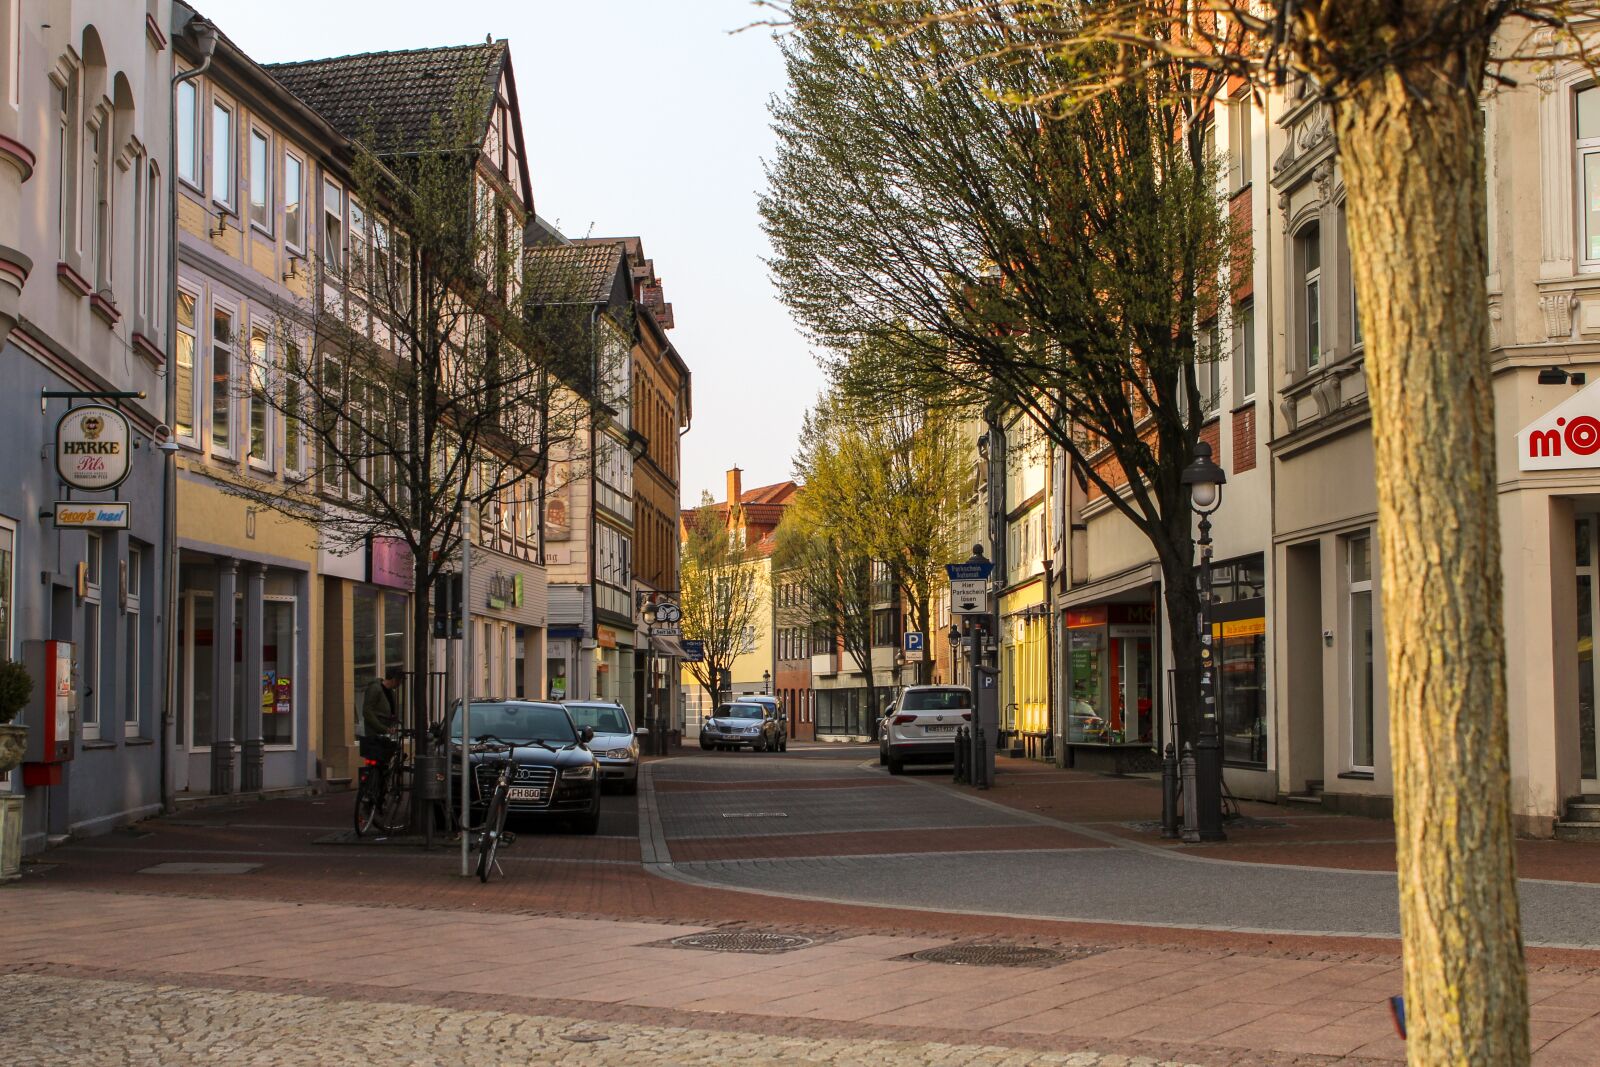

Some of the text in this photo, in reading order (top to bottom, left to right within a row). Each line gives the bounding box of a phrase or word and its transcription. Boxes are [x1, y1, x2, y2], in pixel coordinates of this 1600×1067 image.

[64, 442, 119, 454] HÄRKE
[77, 456, 104, 470] Pils
[59, 508, 124, 524] Georg's Insel
[908, 634, 919, 649] P
[985, 676, 993, 688] P
[524, 789, 540, 798] 800
